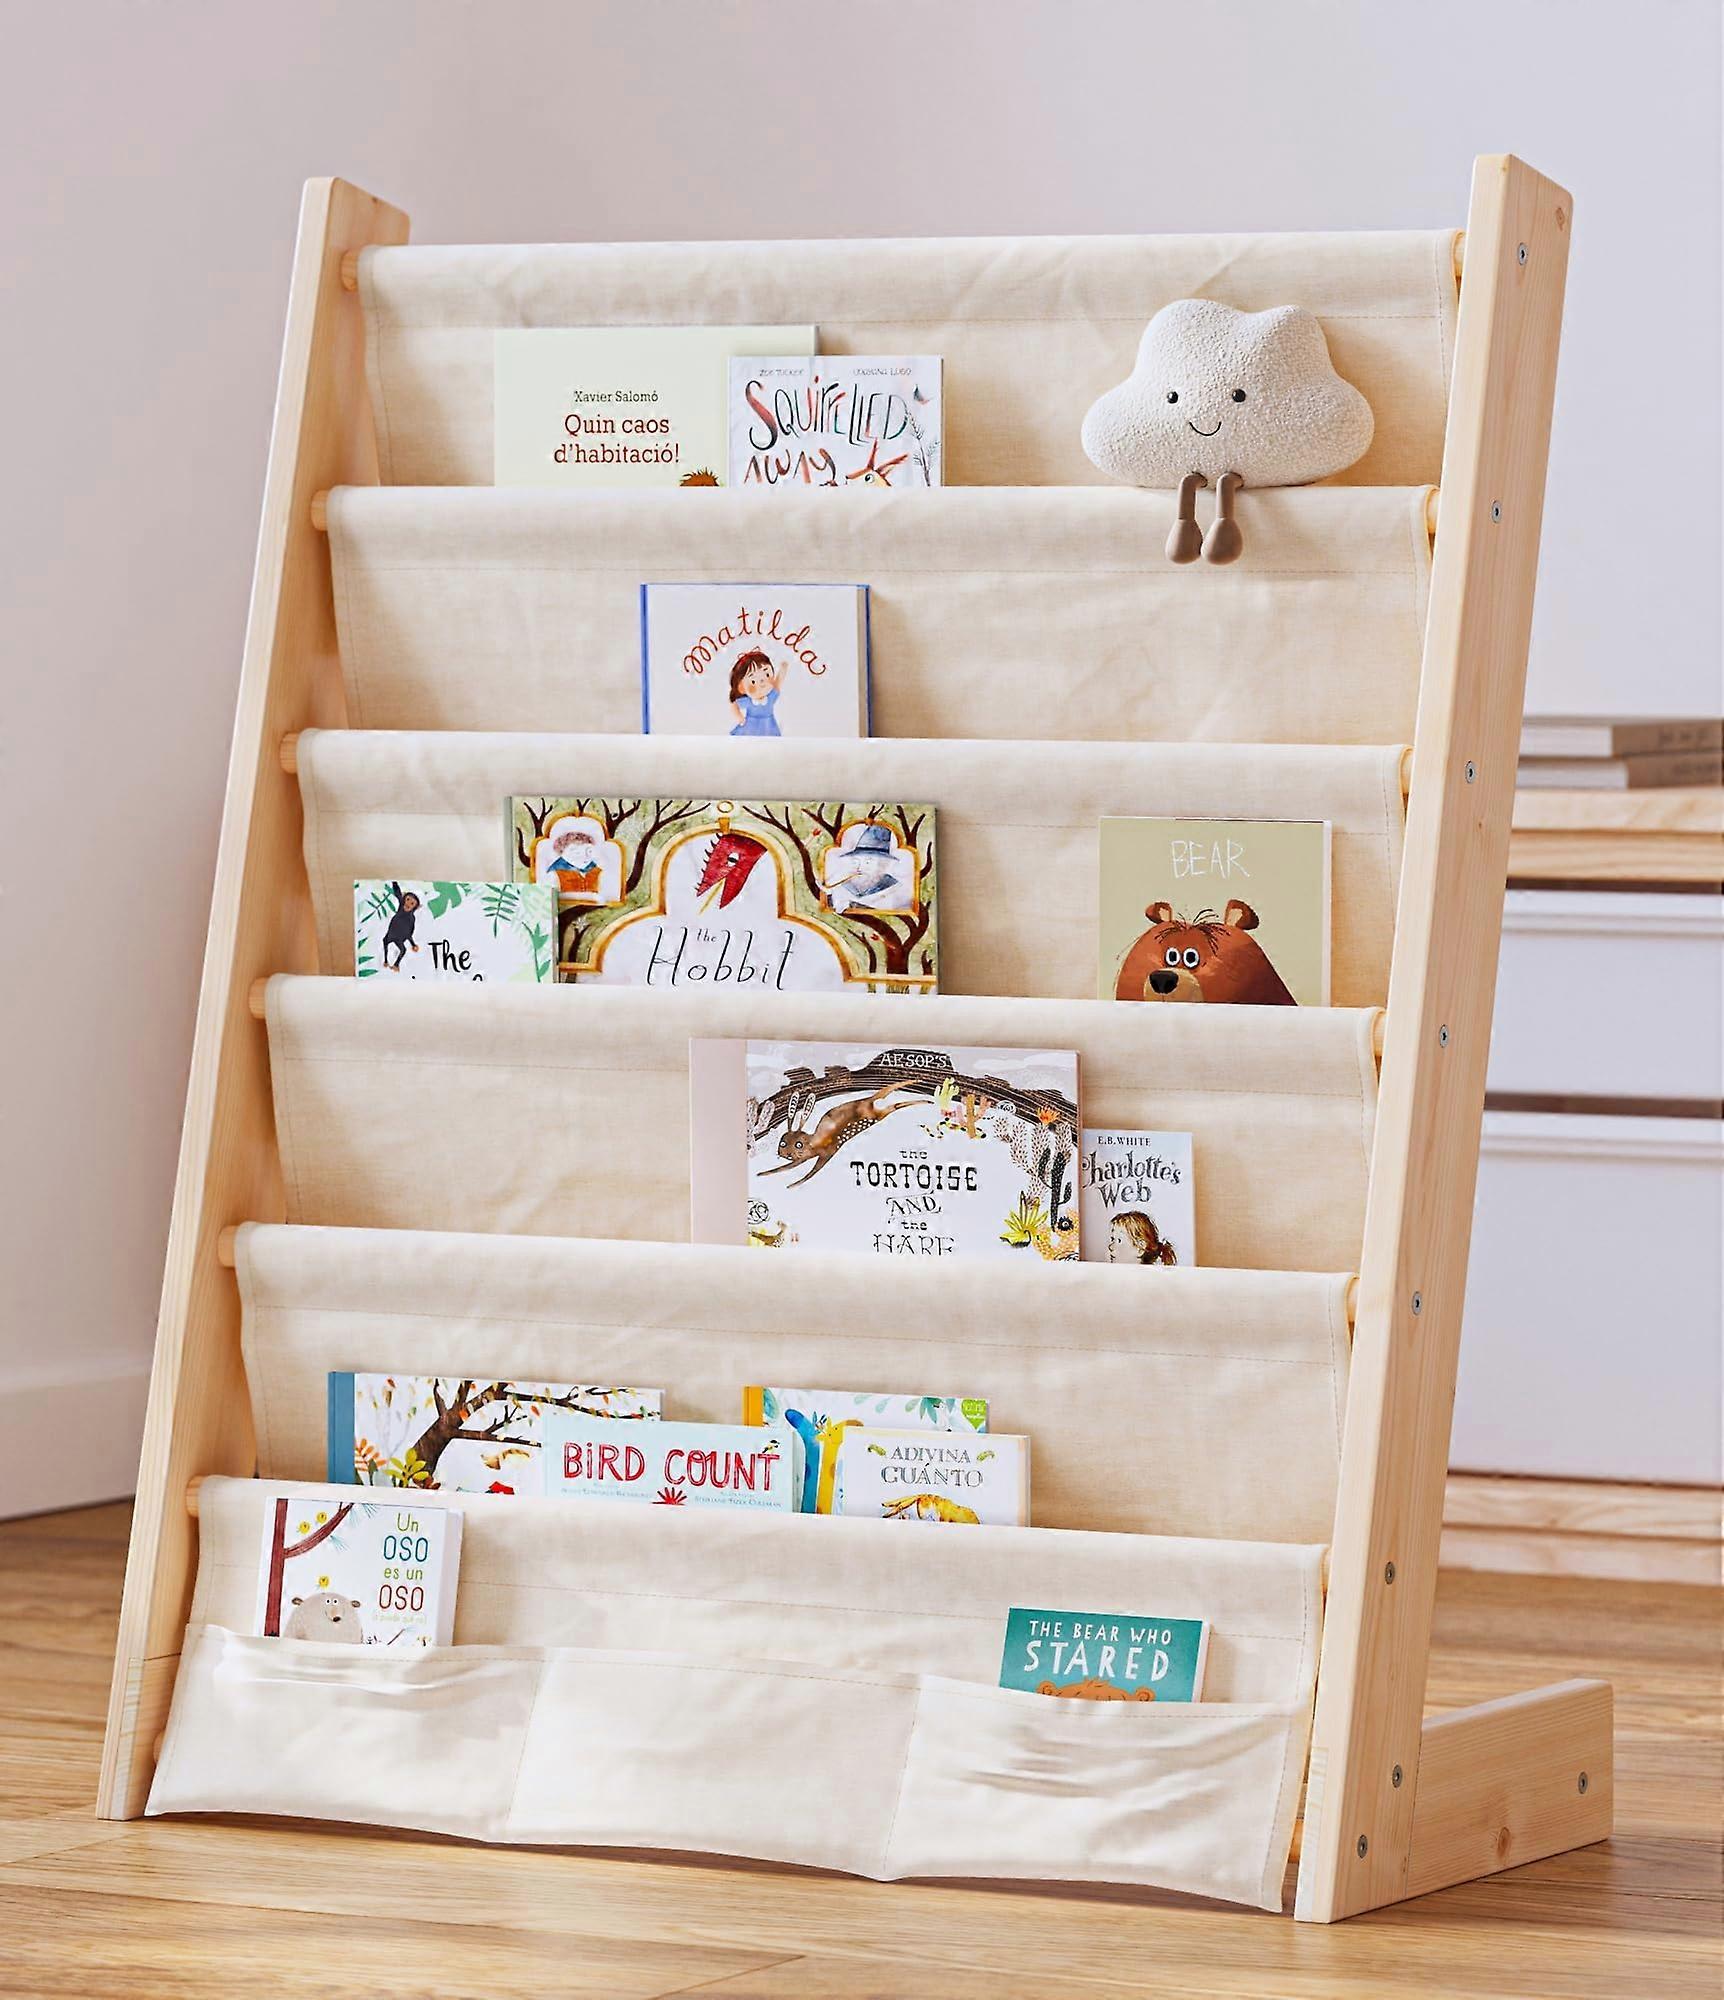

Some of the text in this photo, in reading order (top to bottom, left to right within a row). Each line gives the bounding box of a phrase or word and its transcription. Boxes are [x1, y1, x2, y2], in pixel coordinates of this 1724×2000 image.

[574, 390, 659, 403] Xavier Salomó
[565, 413, 670, 437] Quin caos
[554, 443, 680, 464] d'habitació!
[683, 606, 827, 676] Matilda
[1171, 839, 1250, 879] BEAR
[696, 928, 718, 943] the
[428, 939, 472, 973] The
[647, 925, 794, 990] Hobbit
[880, 1053, 947, 1068] AESOP'S
[899, 1150, 928, 1160] the
[850, 1161, 978, 1191] TORTOISE
[1098, 1178, 1152, 1208] Web
[886, 1191, 942, 1223] AND
[900, 1221, 928, 1231] the
[891, 1446, 971, 1463] ADIVINA
[664, 1449, 781, 1491] COUNT
[881, 1463, 984, 1488] CUÁNTO
[396, 1512, 419, 1533] Un
[383, 1535, 429, 1563] OSO
[384, 1567, 423, 1581] es un
[379, 1584, 424, 1611] OSO
[1029, 1620, 1172, 1645] THE BEAR WHO
[1023, 1640, 1169, 1682] STARED
